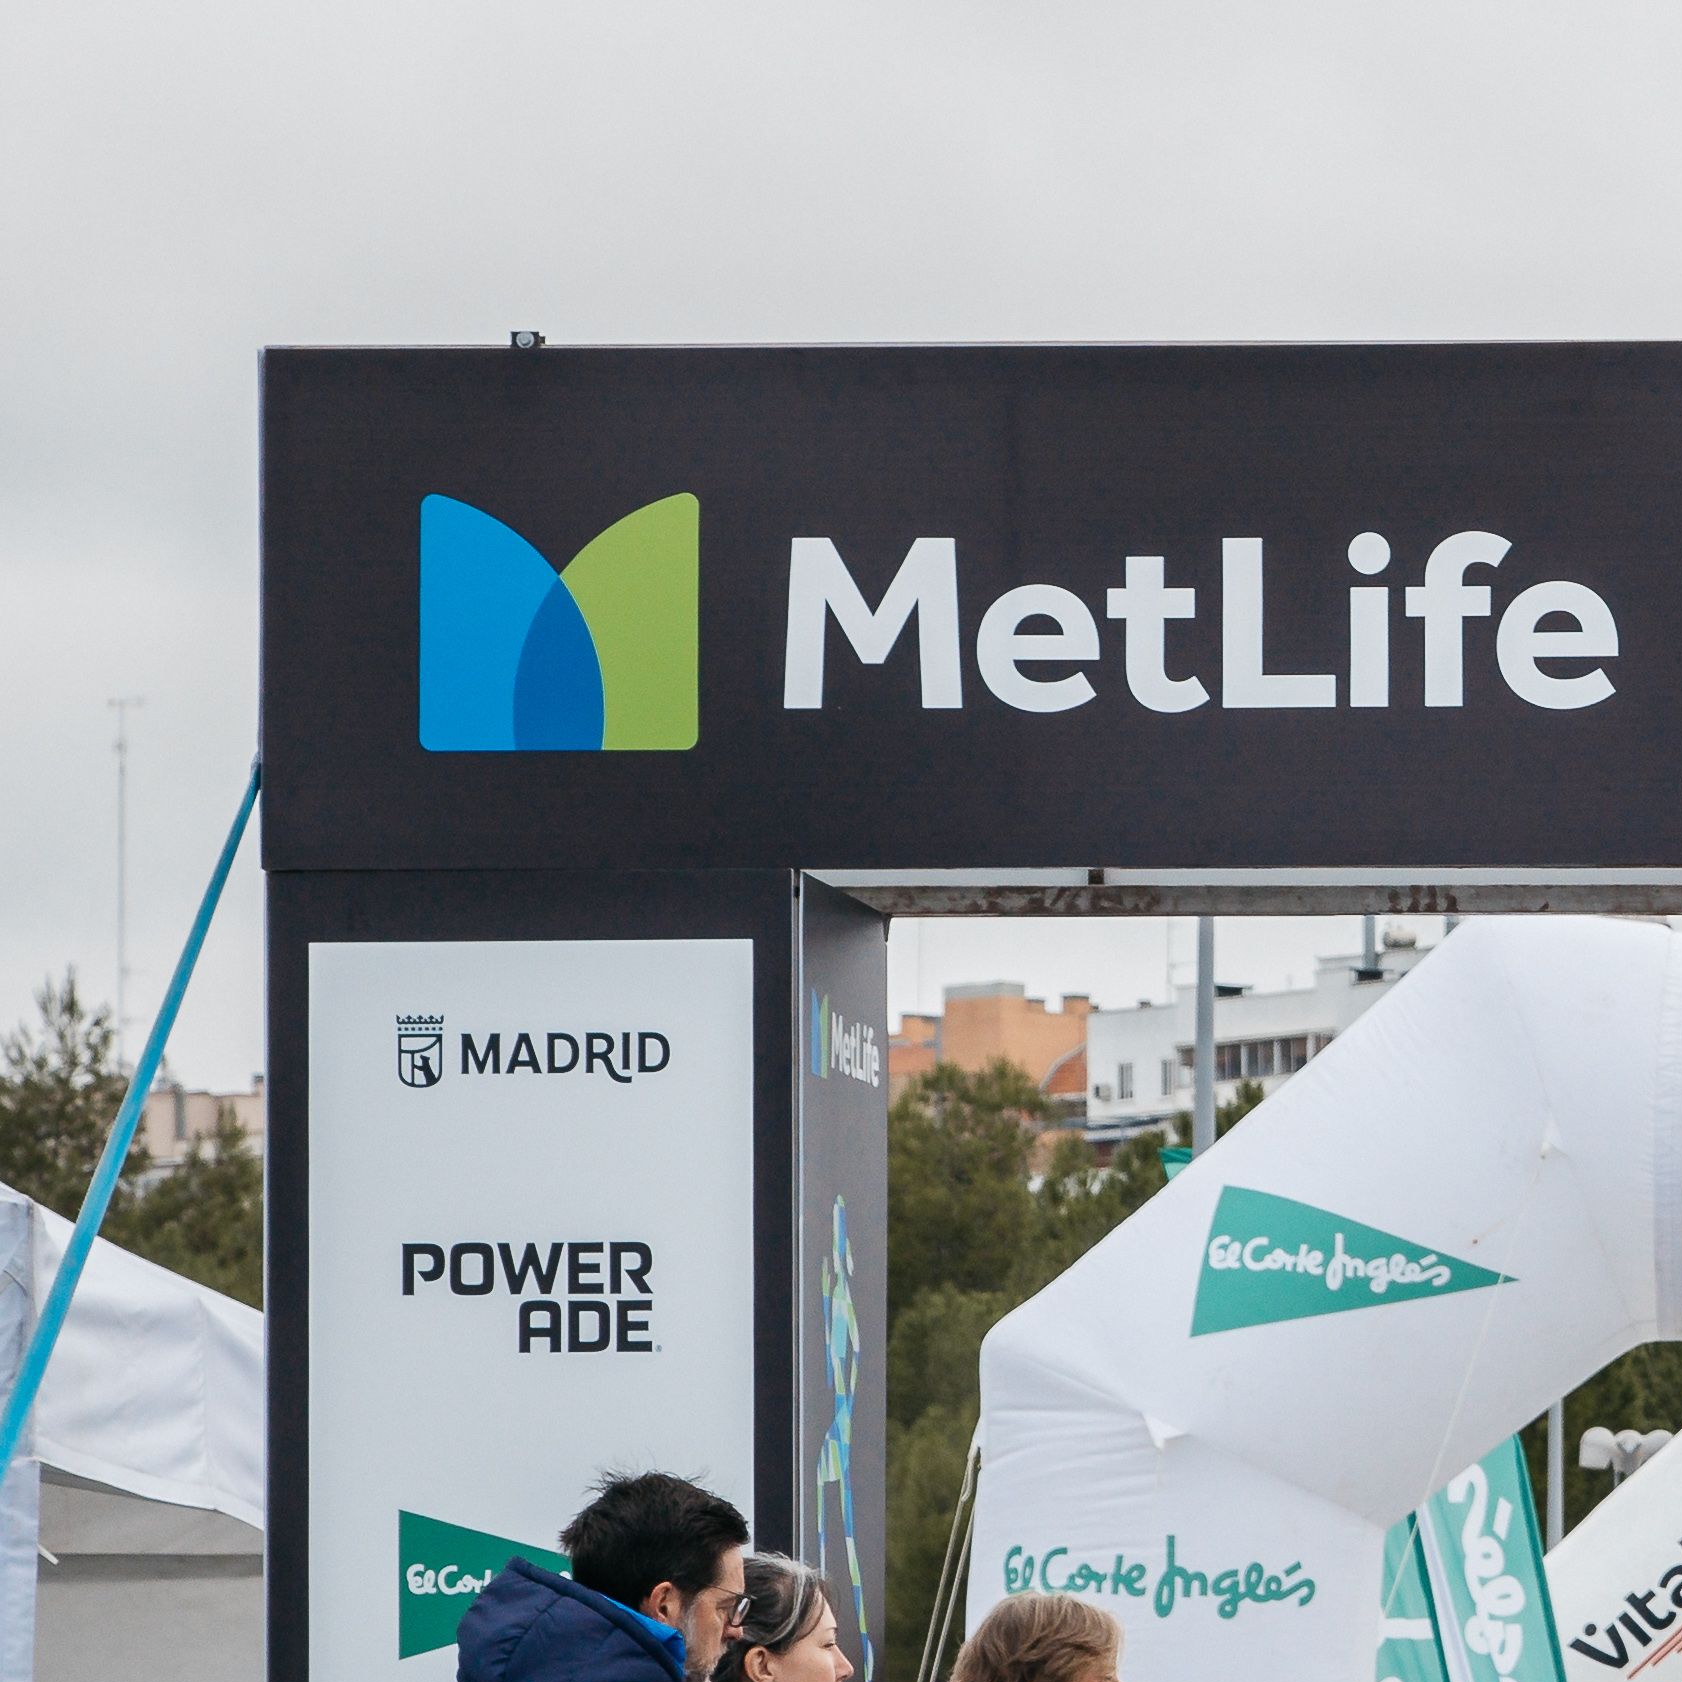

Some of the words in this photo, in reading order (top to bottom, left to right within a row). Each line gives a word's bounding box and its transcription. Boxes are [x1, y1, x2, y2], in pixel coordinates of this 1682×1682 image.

[784, 530, 1620, 713] MetLife
[461, 1031, 671, 1083] MADRID
[831, 1011, 880, 1088] MetLife
[401, 1242, 653, 1296] POWER
[1208, 1235, 1242, 1271] El
[1242, 1237, 1324, 1276] Corte
[1325, 1233, 1451, 1292] Inglés
[519, 1300, 653, 1353] ADE
[406, 1563, 437, 1595] El
[1003, 1546, 1035, 1594] El
[1040, 1547, 1147, 1598] Corte
[1154, 1535, 1316, 1618] Inglés
